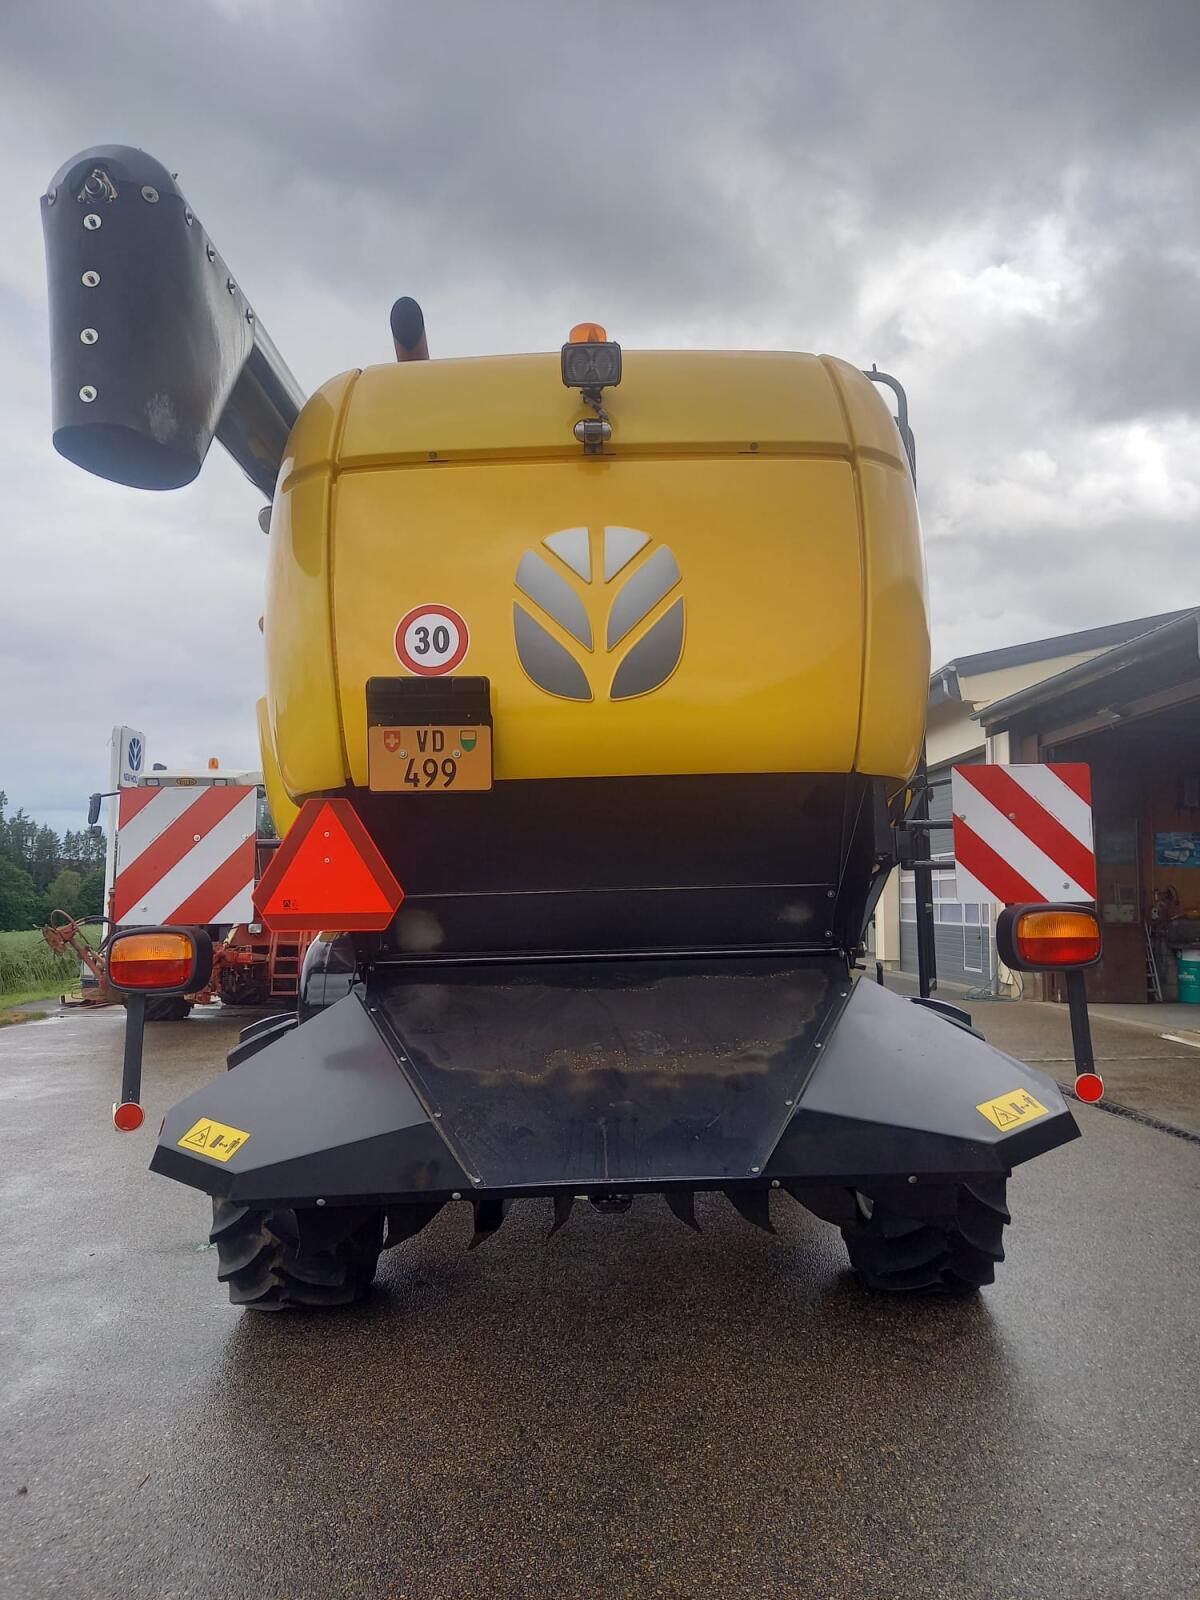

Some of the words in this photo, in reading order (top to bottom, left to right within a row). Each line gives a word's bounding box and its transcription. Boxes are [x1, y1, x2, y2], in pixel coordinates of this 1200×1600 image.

[414, 625, 450, 655] 30
[416, 730, 444, 752] VD
[404, 758, 456, 788] 499
